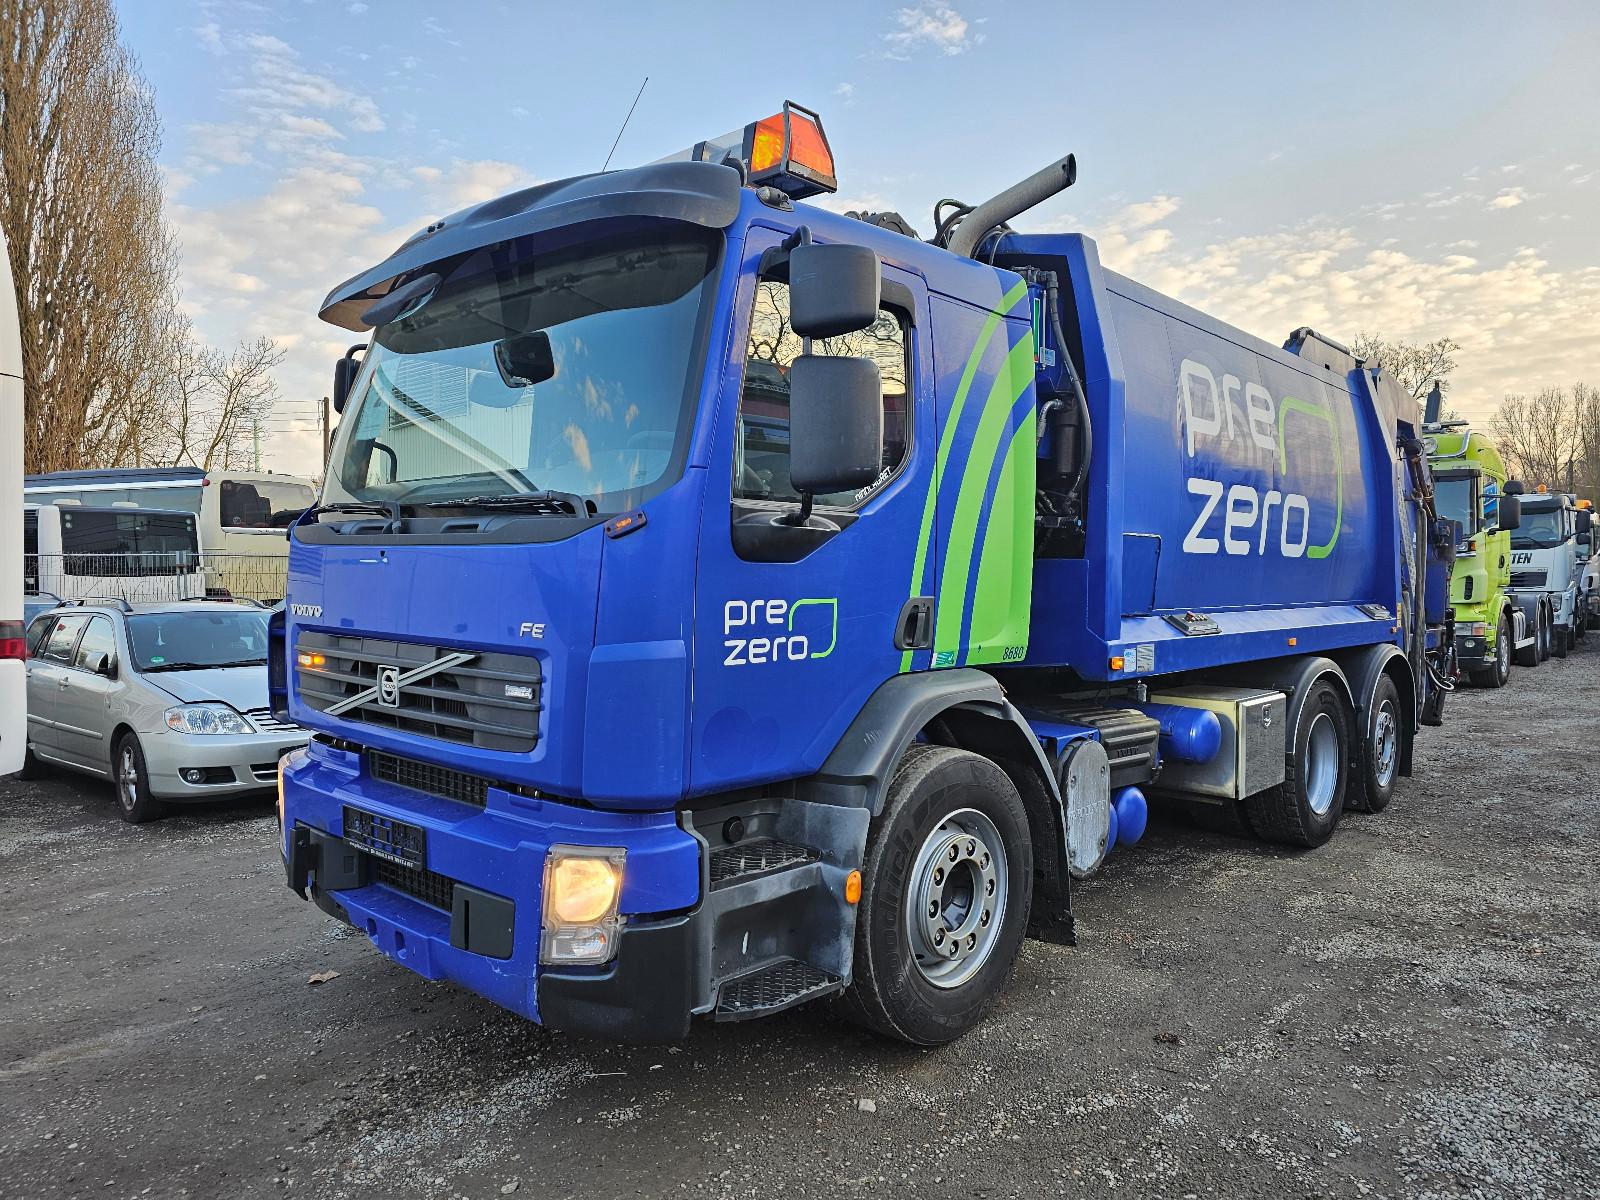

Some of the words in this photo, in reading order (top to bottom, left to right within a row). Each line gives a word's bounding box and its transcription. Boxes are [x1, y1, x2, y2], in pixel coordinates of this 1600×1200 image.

[1180, 358, 1276, 458] pre
[1183, 477, 1311, 559] zero
[1510, 553, 1532, 564] TEN
[290, 603, 323, 618] VOLVO
[724, 599, 788, 635] pre
[519, 622, 546, 639] FE
[723, 635, 809, 667] zero
[1002, 646, 1025, 661] 8680
